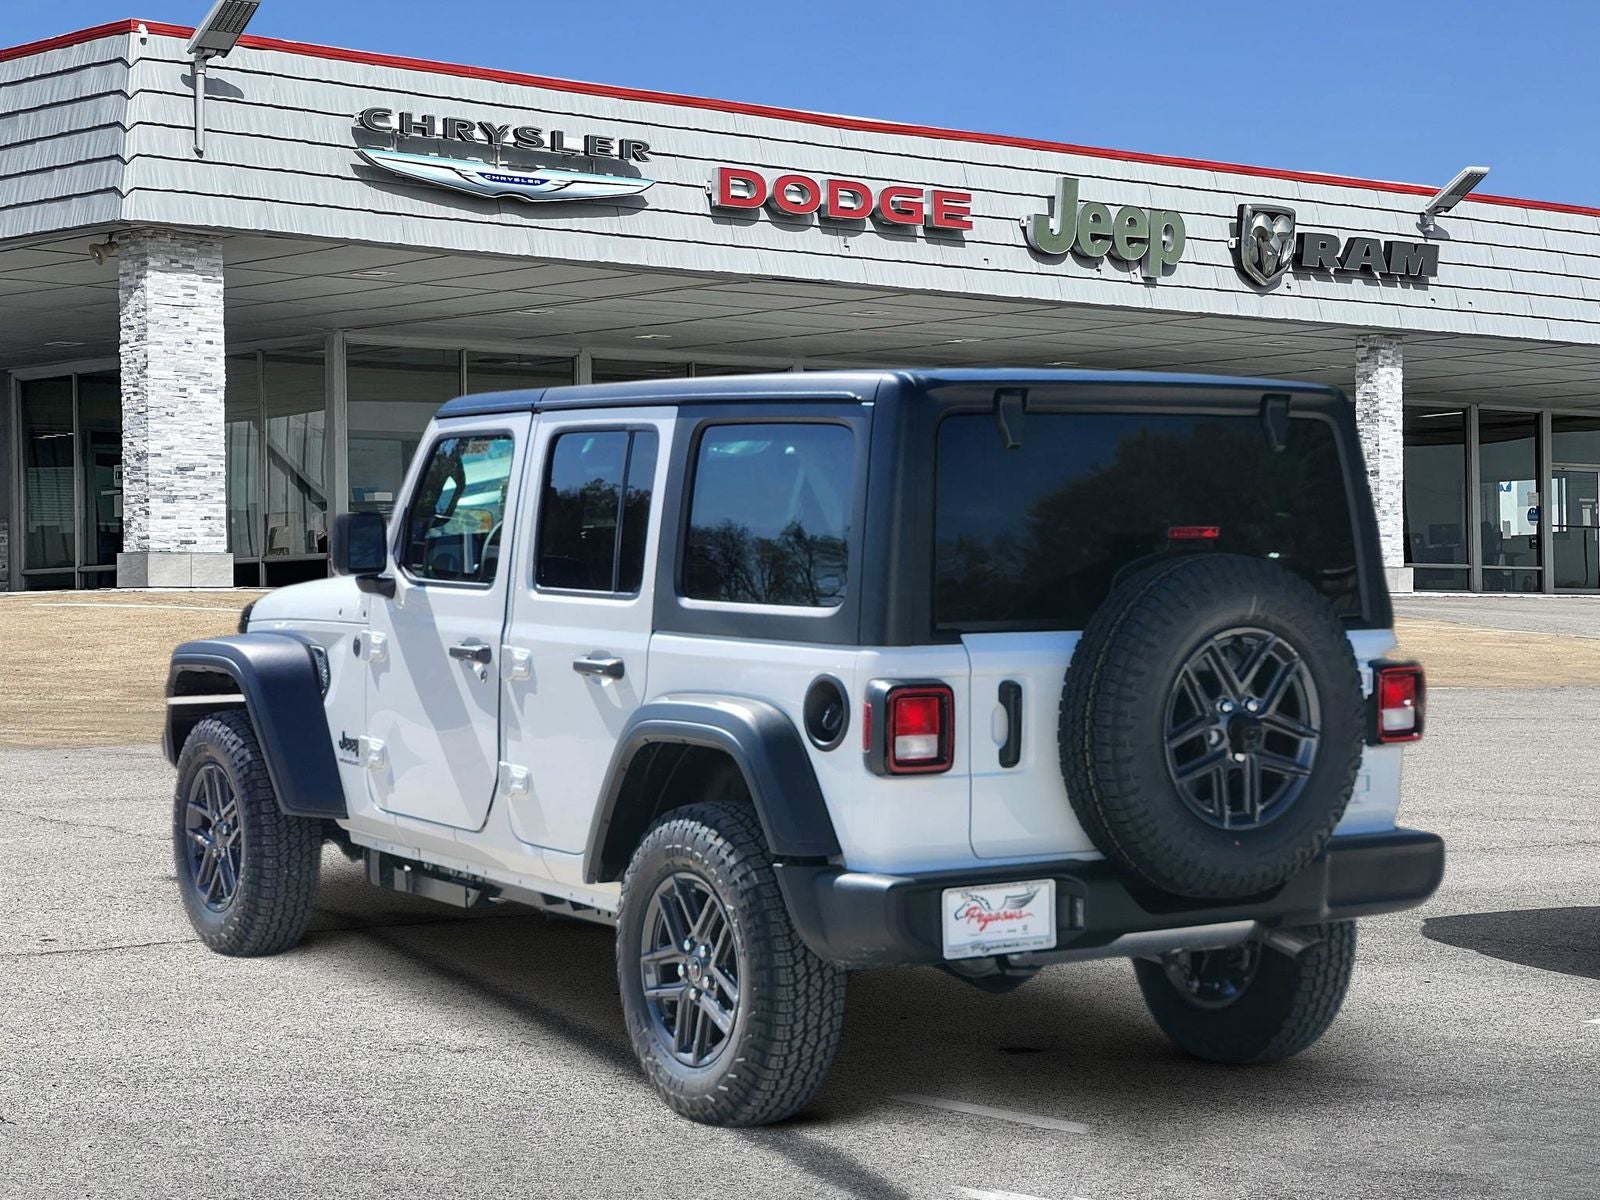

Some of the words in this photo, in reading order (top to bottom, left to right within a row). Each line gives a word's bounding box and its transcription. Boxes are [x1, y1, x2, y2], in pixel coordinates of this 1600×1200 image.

[358, 107, 651, 162] CHRYSLER
[484, 174, 541, 185] CHRYSLER
[712, 167, 974, 231] DODGE
[1026, 177, 1186, 278] Jeep
[1296, 232, 1440, 277] RAM
